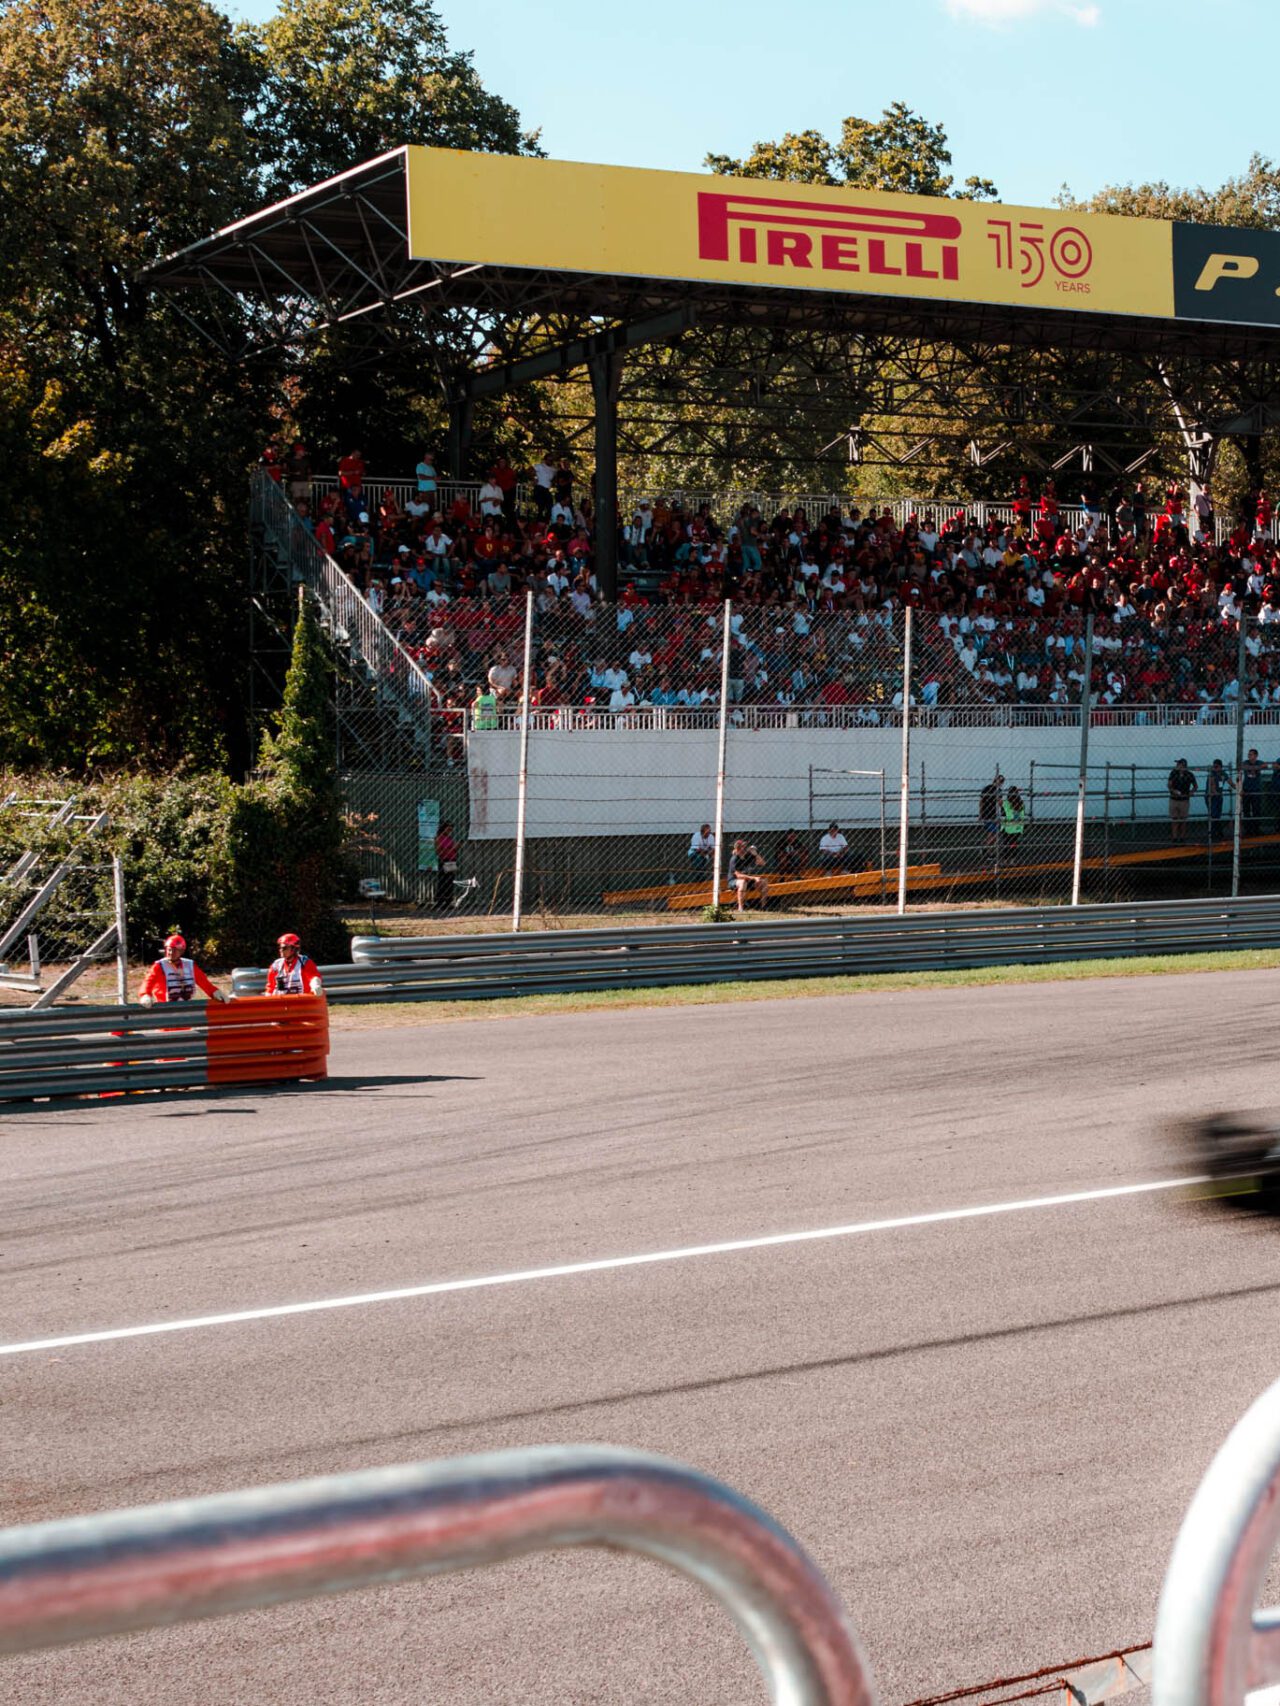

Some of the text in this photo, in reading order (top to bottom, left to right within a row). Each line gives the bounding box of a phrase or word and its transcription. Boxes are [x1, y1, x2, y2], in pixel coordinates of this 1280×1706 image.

[697, 191, 1093, 288] PIRELLI 150
[1054, 281, 1092, 294] YEARS
[1195, 254, 1258, 290] P
